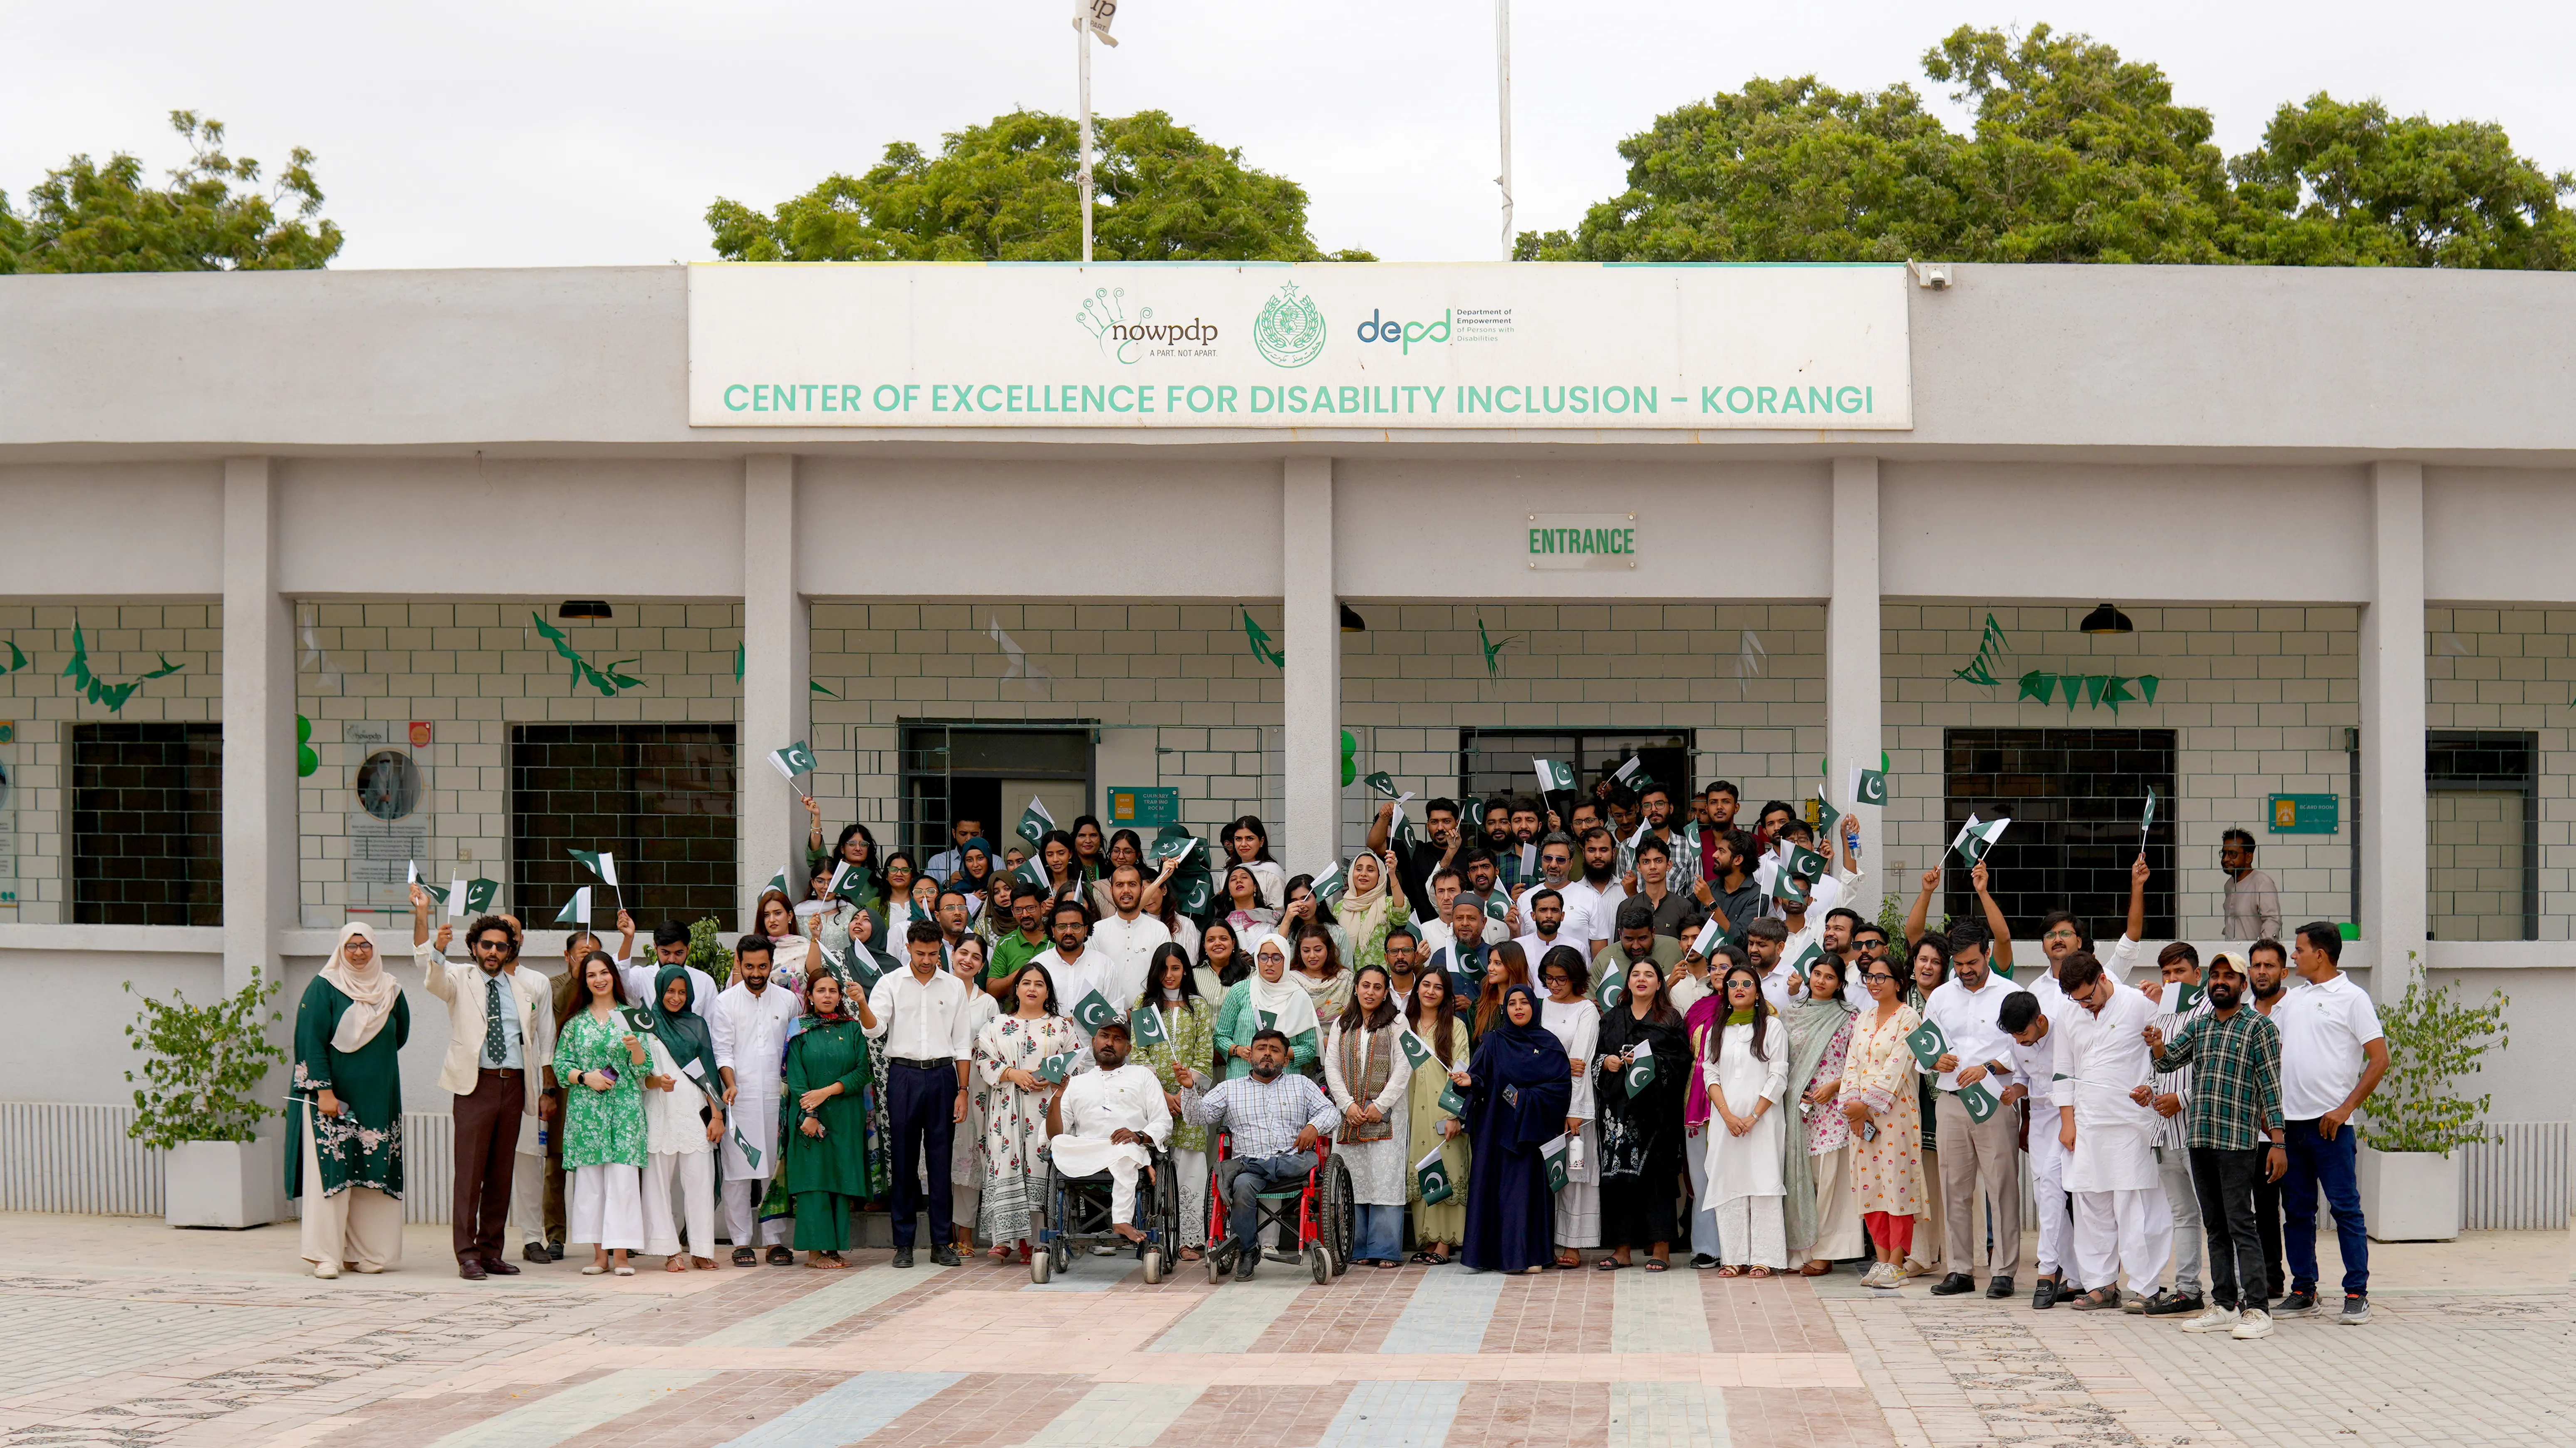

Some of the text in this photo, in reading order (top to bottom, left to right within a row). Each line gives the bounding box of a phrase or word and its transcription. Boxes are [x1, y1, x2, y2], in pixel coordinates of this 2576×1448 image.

[1112, 317, 1218, 345] nowpdp
[724, 384, 862, 412] CENTER
[873, 384, 921, 412] OF
[932, 384, 1154, 413] EXCELLENCE
[1168, 385, 1238, 413] FOR
[1251, 386, 1445, 413] DISABILITY
[1458, 385, 1657, 413] INCLUSION
[1702, 385, 1872, 414] KORANGI
[1529, 528, 1635, 553] ENTRANCE
